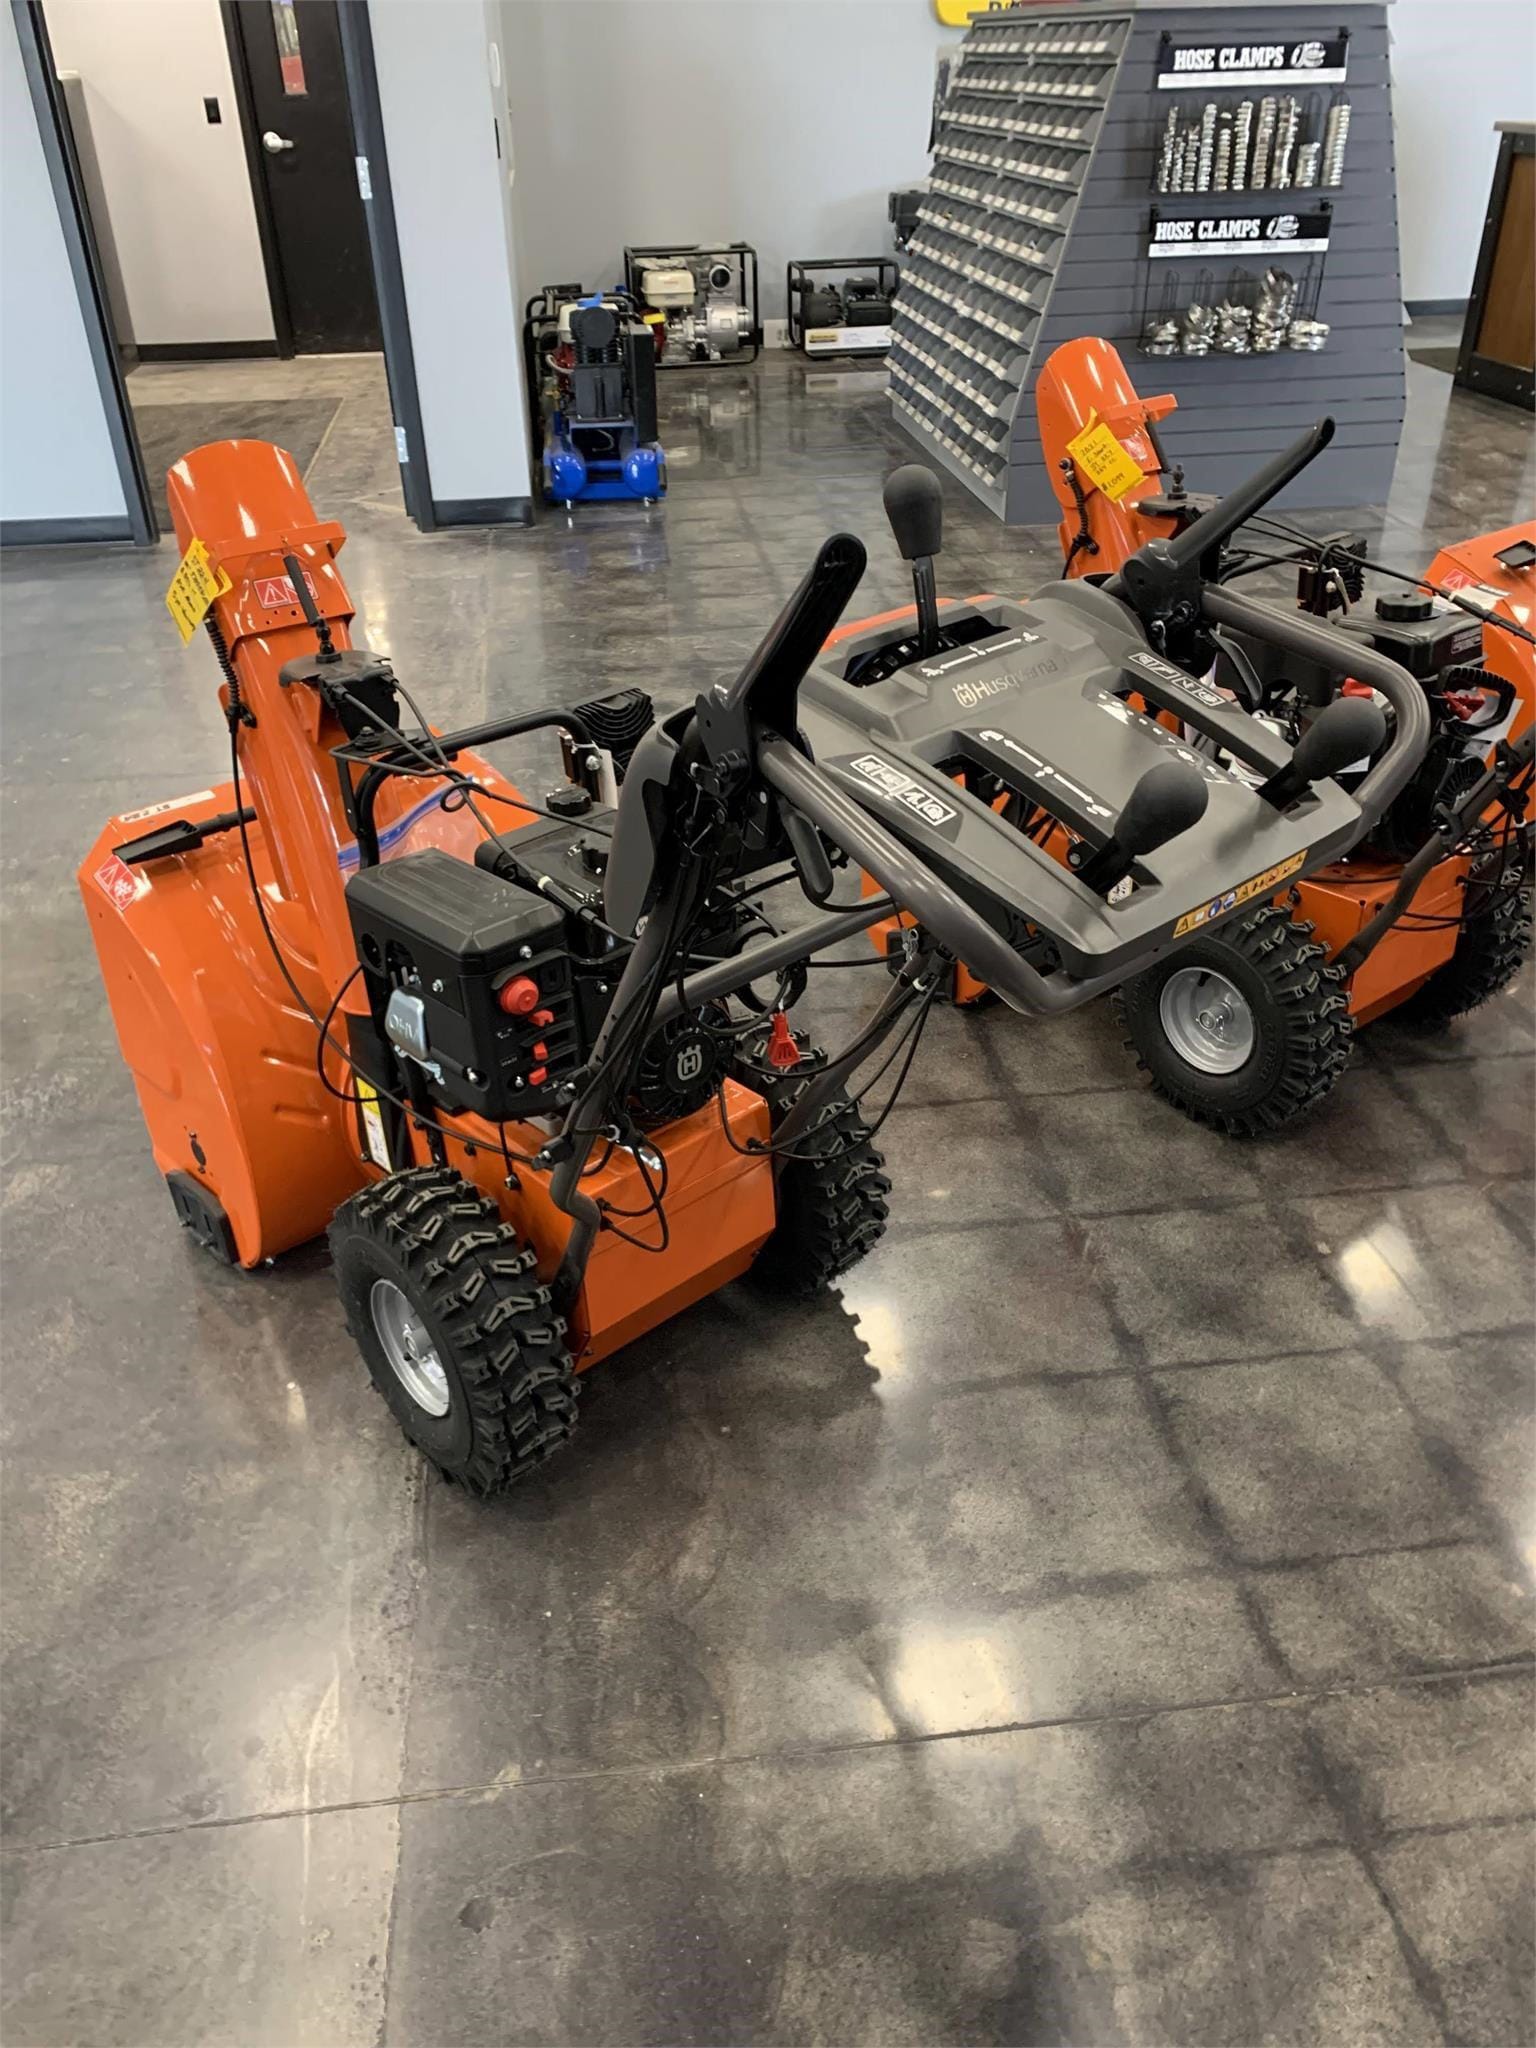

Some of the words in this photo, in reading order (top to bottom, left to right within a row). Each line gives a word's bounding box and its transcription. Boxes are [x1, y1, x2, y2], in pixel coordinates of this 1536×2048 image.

[1173, 48, 1215, 71] HOSE
[1218, 46, 1285, 69] CLAMPS
[1154, 221, 1195, 241] HOSE
[1197, 218, 1261, 240] CLAMPS
[971, 658, 1058, 700] Husqvarna
